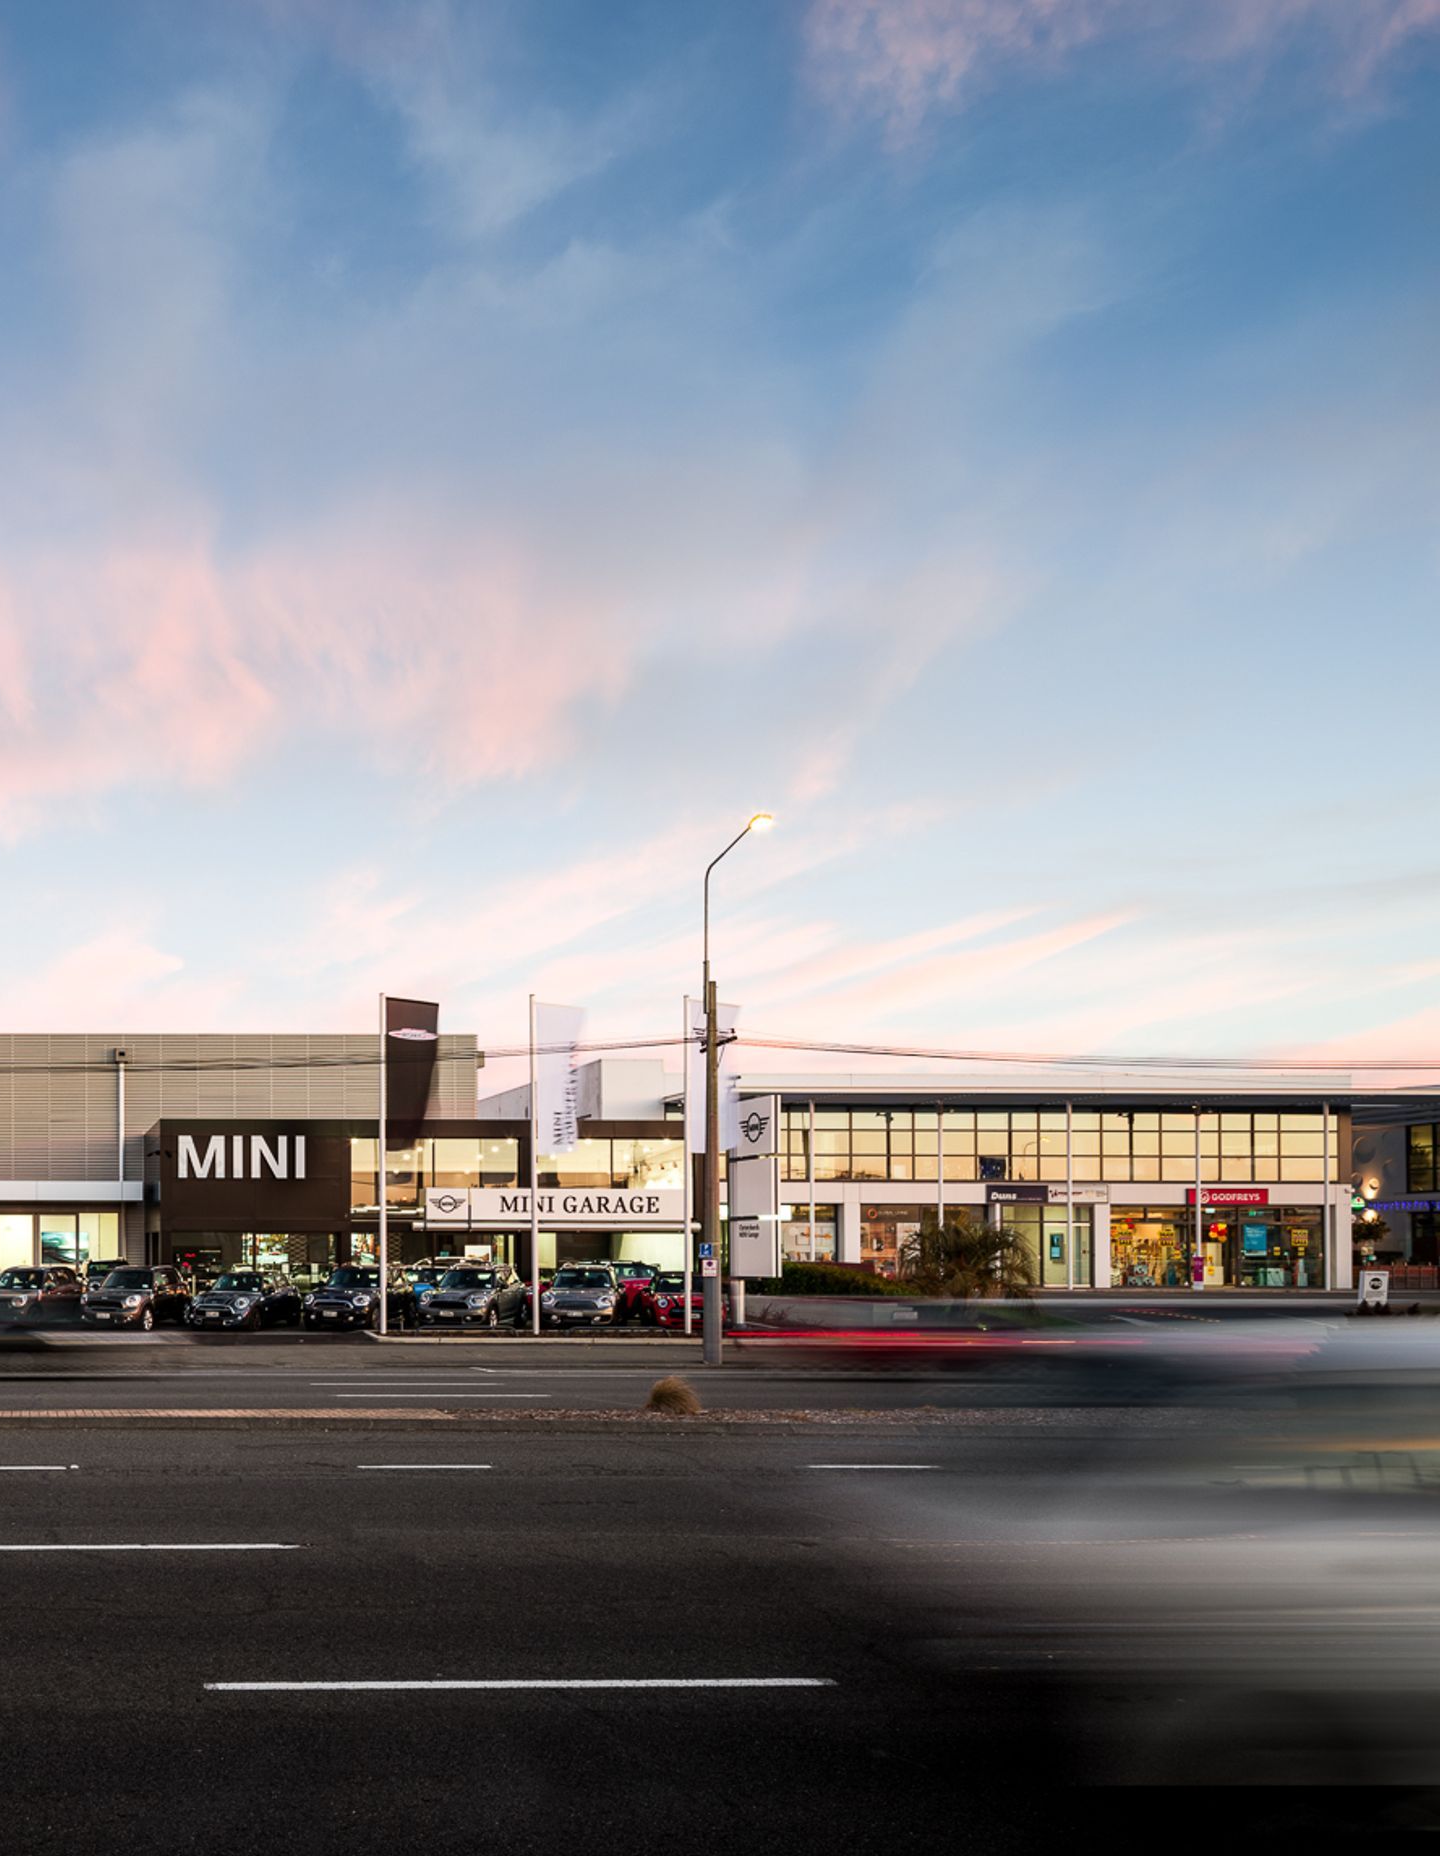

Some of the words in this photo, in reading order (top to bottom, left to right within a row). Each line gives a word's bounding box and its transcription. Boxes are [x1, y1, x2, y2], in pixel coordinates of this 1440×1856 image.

[177, 1134, 306, 1179] MINI
[500, 1195, 555, 1213] MINI
[562, 1196, 660, 1214] GARAGE
[1211, 1193, 1261, 1201] GODFREYS
